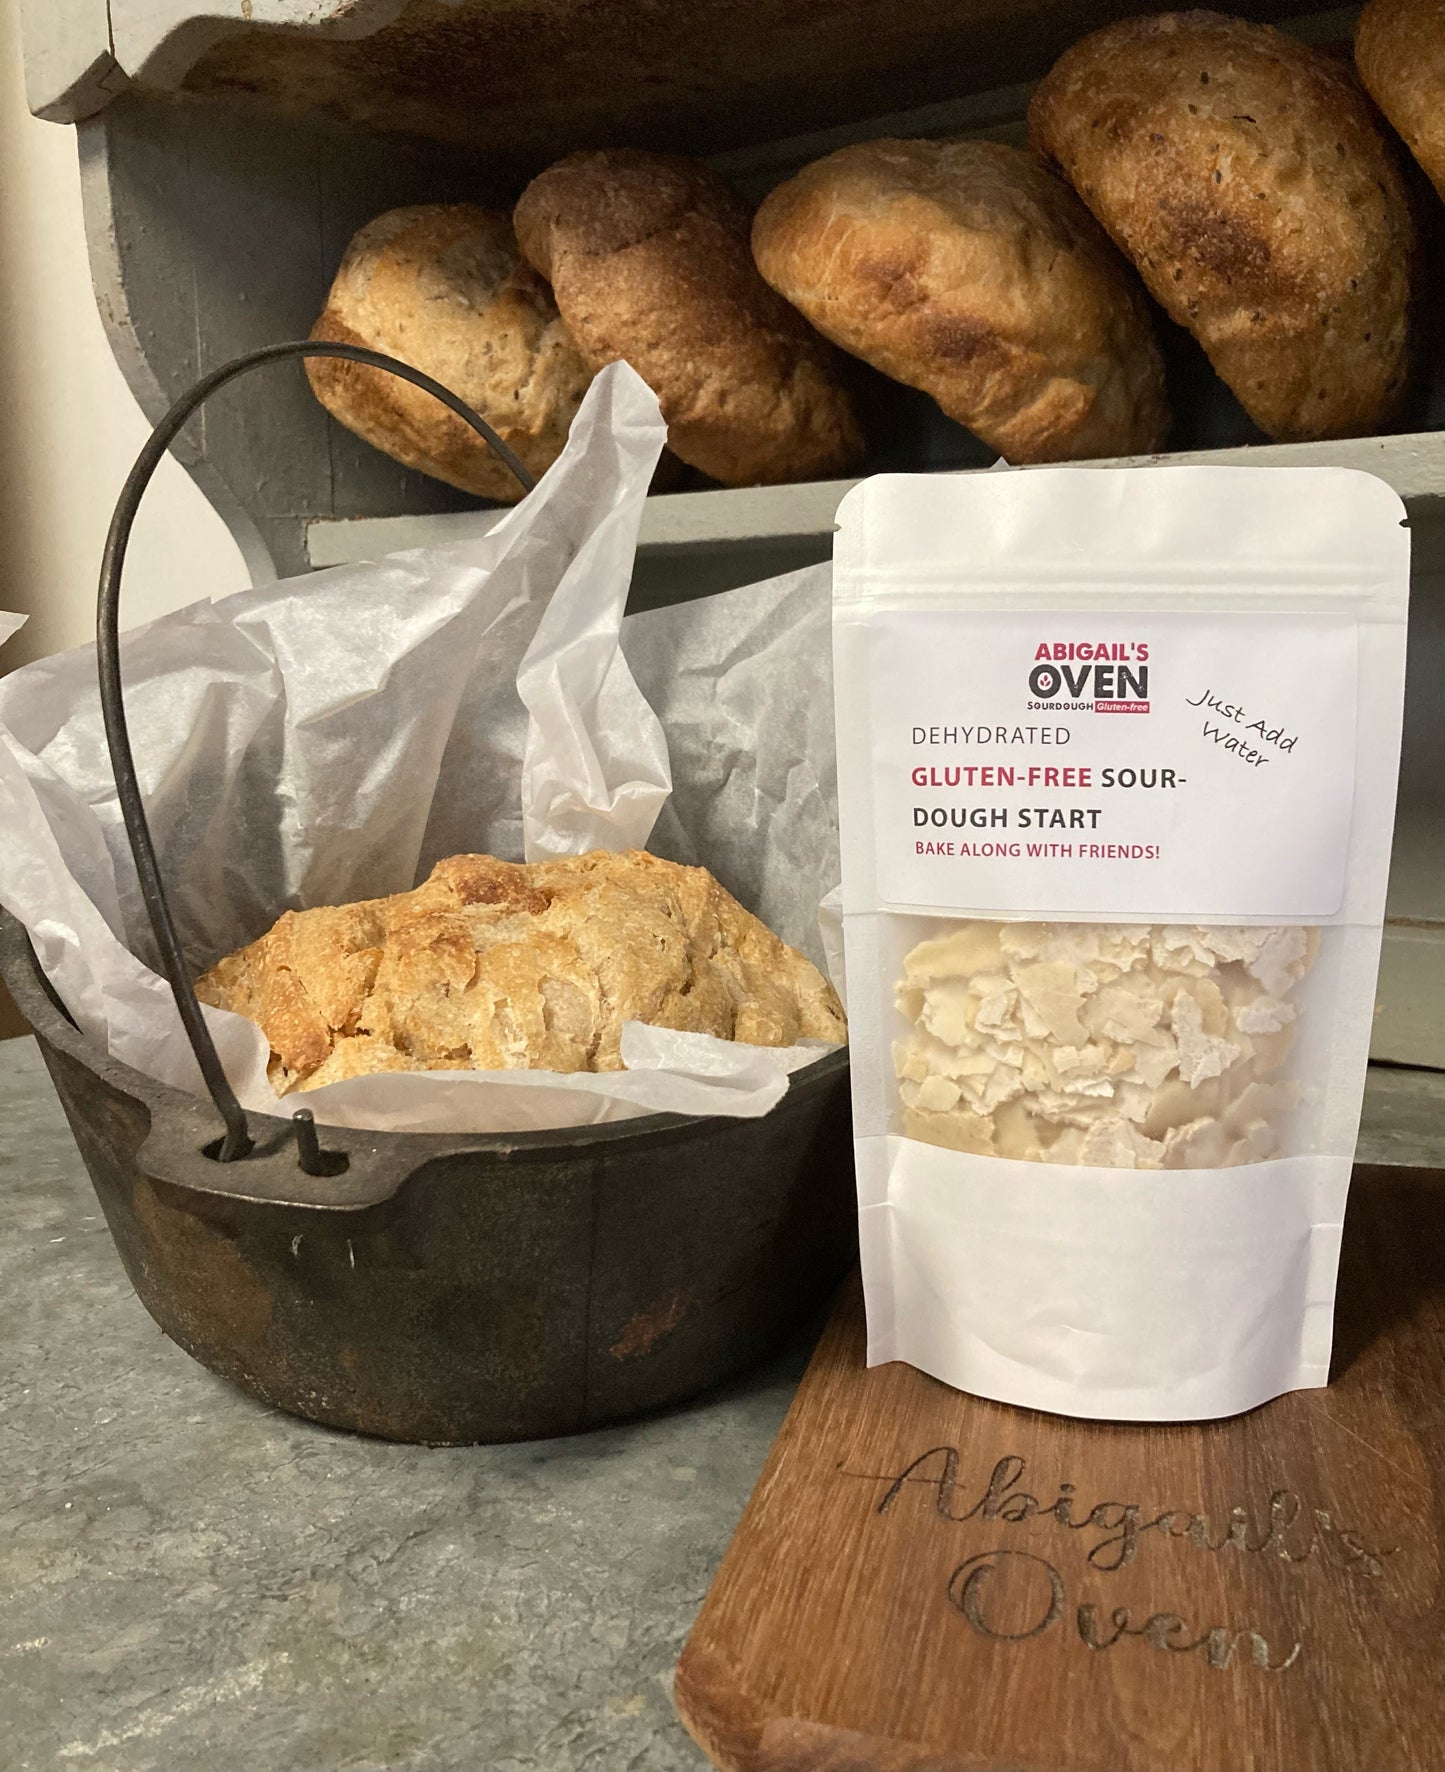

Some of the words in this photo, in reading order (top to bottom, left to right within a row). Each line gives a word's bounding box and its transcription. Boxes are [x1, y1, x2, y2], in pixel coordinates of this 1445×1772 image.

[1034, 642, 1149, 662] ABIGAIL'S
[1028, 664, 1149, 699] OVEN
[1027, 701, 1094, 712] SOURDOUGH
[1096, 702, 1149, 712] Gluten-free
[1186, 690, 1246, 724] Just
[1246, 719, 1298, 754] Add
[912, 727, 1071, 746] DEHYDRATED
[1202, 721, 1269, 768] Water
[911, 767, 1092, 788] GLUTEN-FREE
[1101, 768, 1187, 789] SOUR-
[913, 807, 1008, 829] DOUGH
[1018, 808, 1102, 829] START
[915, 841, 955, 857] BAKE
[960, 842, 1021, 858] ALONG
[1026, 843, 1073, 859] WITH
[1079, 844, 1160, 860] FRIENDS!
[948, 1549, 1301, 1671] Oven
